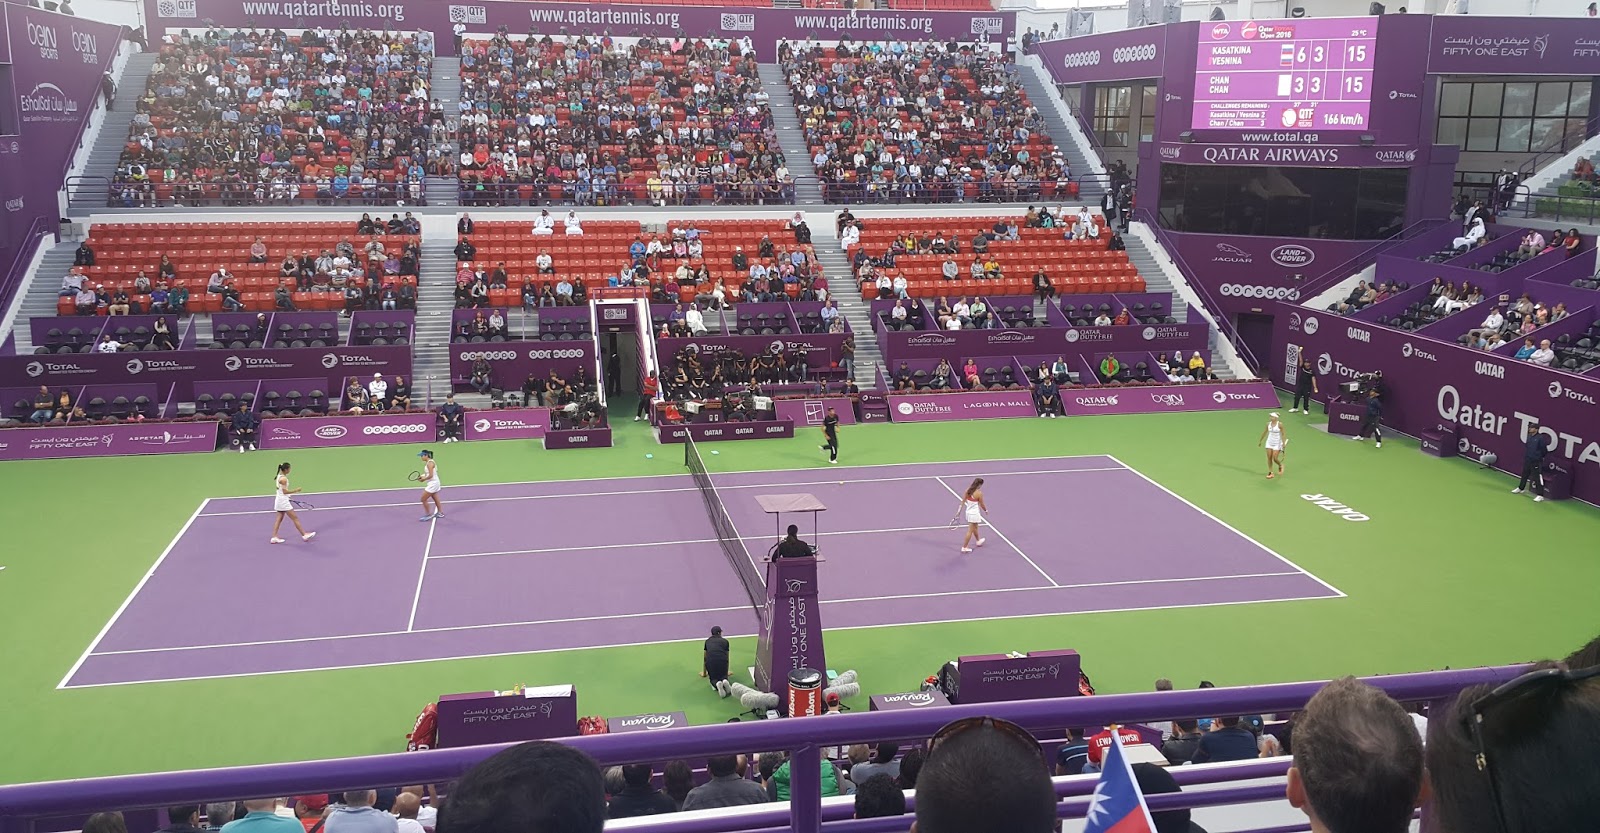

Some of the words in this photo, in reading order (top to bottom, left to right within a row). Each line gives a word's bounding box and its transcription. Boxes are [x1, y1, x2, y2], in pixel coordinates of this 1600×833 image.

[178, 0, 195, 10] QTF
[243, 0, 404, 21] www.qatartennis.org
[468, 6, 485, 16] QTF
[530, 8, 679, 28] www.qatartennis.org
[738, 14, 753, 24] QTF
[795, 14, 933, 33] www.qatartennis.org
[988, 18, 1001, 28] QTF
[1258, 25, 1274, 33] Qatar
[1260, 31, 1275, 39] Open
[40, 47, 59, 60] SPORTS
[82, 53, 98, 64] SPORTS
[1113, 44, 1156, 63] ooredoo
[1212, 45, 1252, 55] KASATKINA
[1297, 46, 1307, 63] 6
[1313, 46, 1324, 62] 3
[1348, 45, 1366, 62] 15
[1443, 48, 1473, 56] FIFTY
[1500, 48, 1529, 56] EAST
[1065, 50, 1100, 68] ooredoo
[1212, 56, 1242, 65] VESNINA
[1209, 85, 1229, 94] CHAN
[1210, 76, 1230, 84] CHAN
[1294, 76, 1304, 93] 3
[1310, 76, 1321, 93] 3
[1345, 76, 1363, 93] 15
[1298, 108, 1314, 119] QTF
[1324, 113, 1339, 125] 166
[1340, 112, 1363, 125] km/h
[1242, 131, 1319, 143] www.total.qa
[1204, 148, 1260, 162] QATAR
[1264, 148, 1339, 162] AIRWAYS
[1375, 150, 1405, 160] QATAR
[1220, 283, 1300, 301] ooredoo
[1306, 322, 1317, 330] WTA
[1347, 326, 1371, 343] QATAR
[460, 350, 517, 362] ooedoo
[1414, 348, 1437, 362] TOTAL
[1286, 365, 1297, 376] QTF
[1334, 361, 1361, 379] TOTA
[1474, 360, 1505, 379] QATAR
[1076, 396, 1105, 406] QATAR
[1151, 392, 1183, 403] beIN
[1564, 387, 1596, 405] TOTAL
[1340, 412, 1360, 422] QATAR
[1437, 385, 1508, 436] Qatar
[363, 423, 427, 435] ooredoo
[672, 430, 692, 438] QAT
[735, 427, 754, 435] QATAR
[568, 435, 588, 443] QATAR
[1471, 443, 1497, 457] TOTA
[1300, 493, 1370, 521] QATAR
[799, 597, 808, 625] EAST
[799, 627, 808, 652] ONE
[982, 675, 1004, 683] FIFTY
[1025, 672, 1046, 680] EAST
[805, 691, 815, 717] ilson
[884, 693, 935, 706] Rayyan
[463, 715, 488, 724] FIFTY
[490, 714, 511, 722] ONE
[513, 711, 536, 719] EAST
[621, 715, 674, 730] Rayyan
